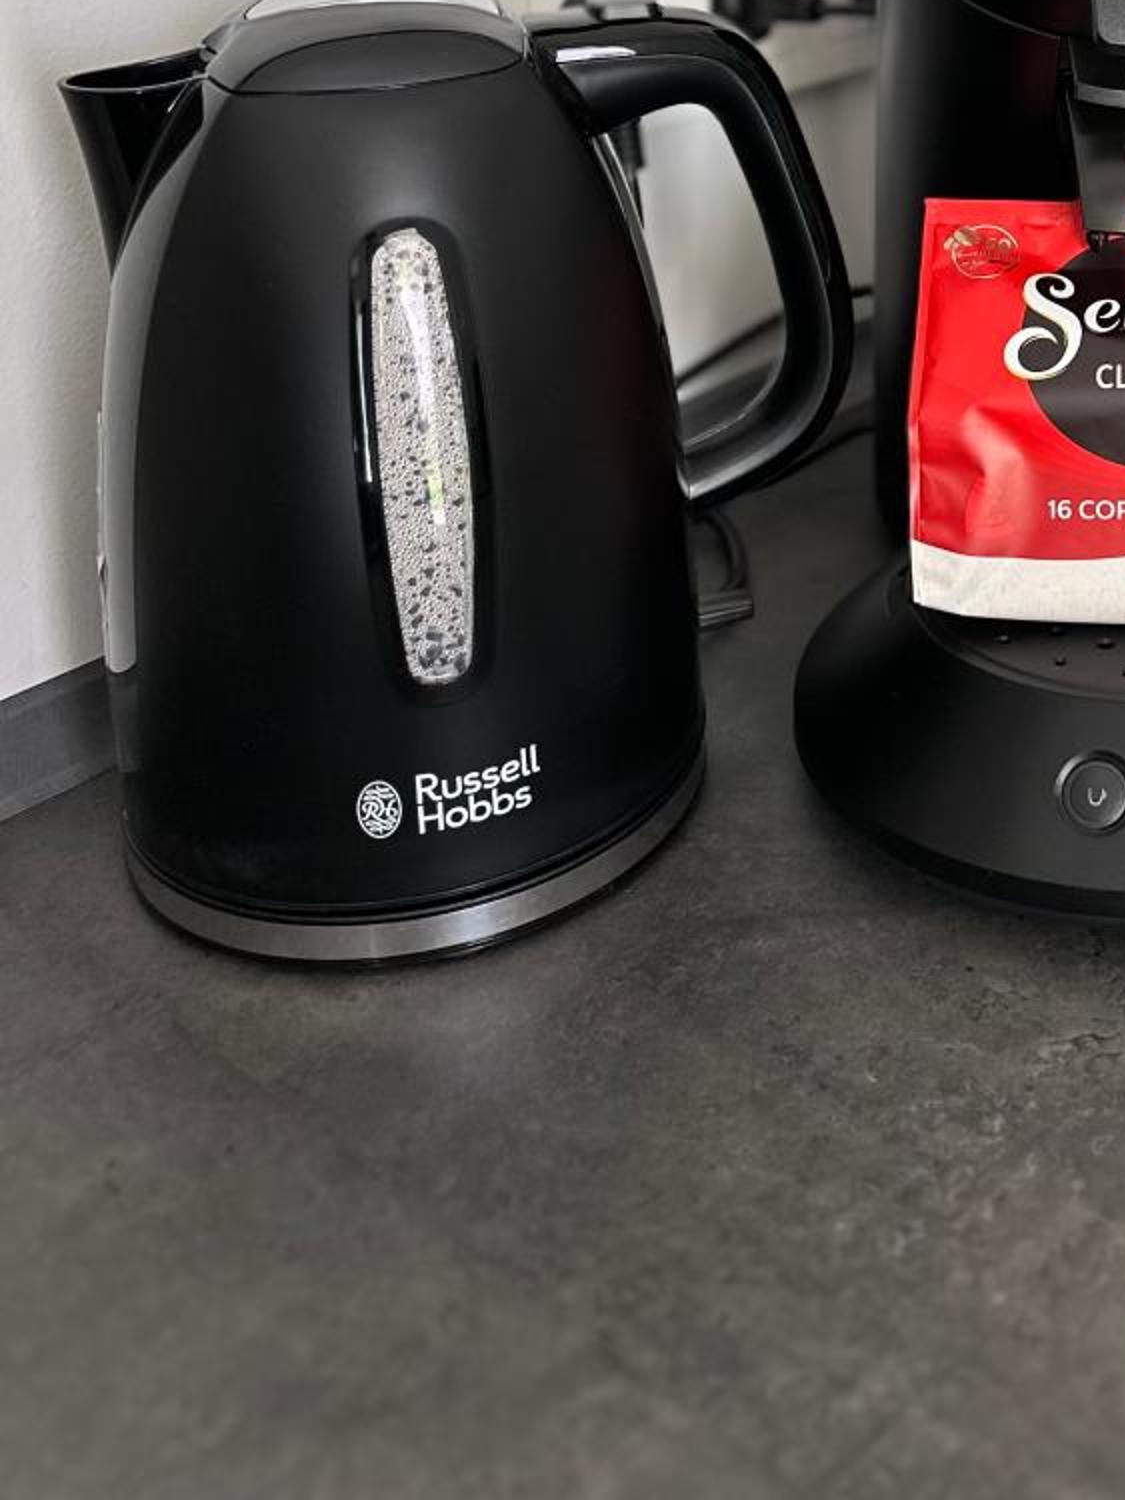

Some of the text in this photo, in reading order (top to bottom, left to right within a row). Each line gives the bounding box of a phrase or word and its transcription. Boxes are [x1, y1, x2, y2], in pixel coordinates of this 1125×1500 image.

[1047, 499, 1073, 520] 16
[415, 743, 541, 805] Russell
[417, 785, 533, 835] Hobbs
